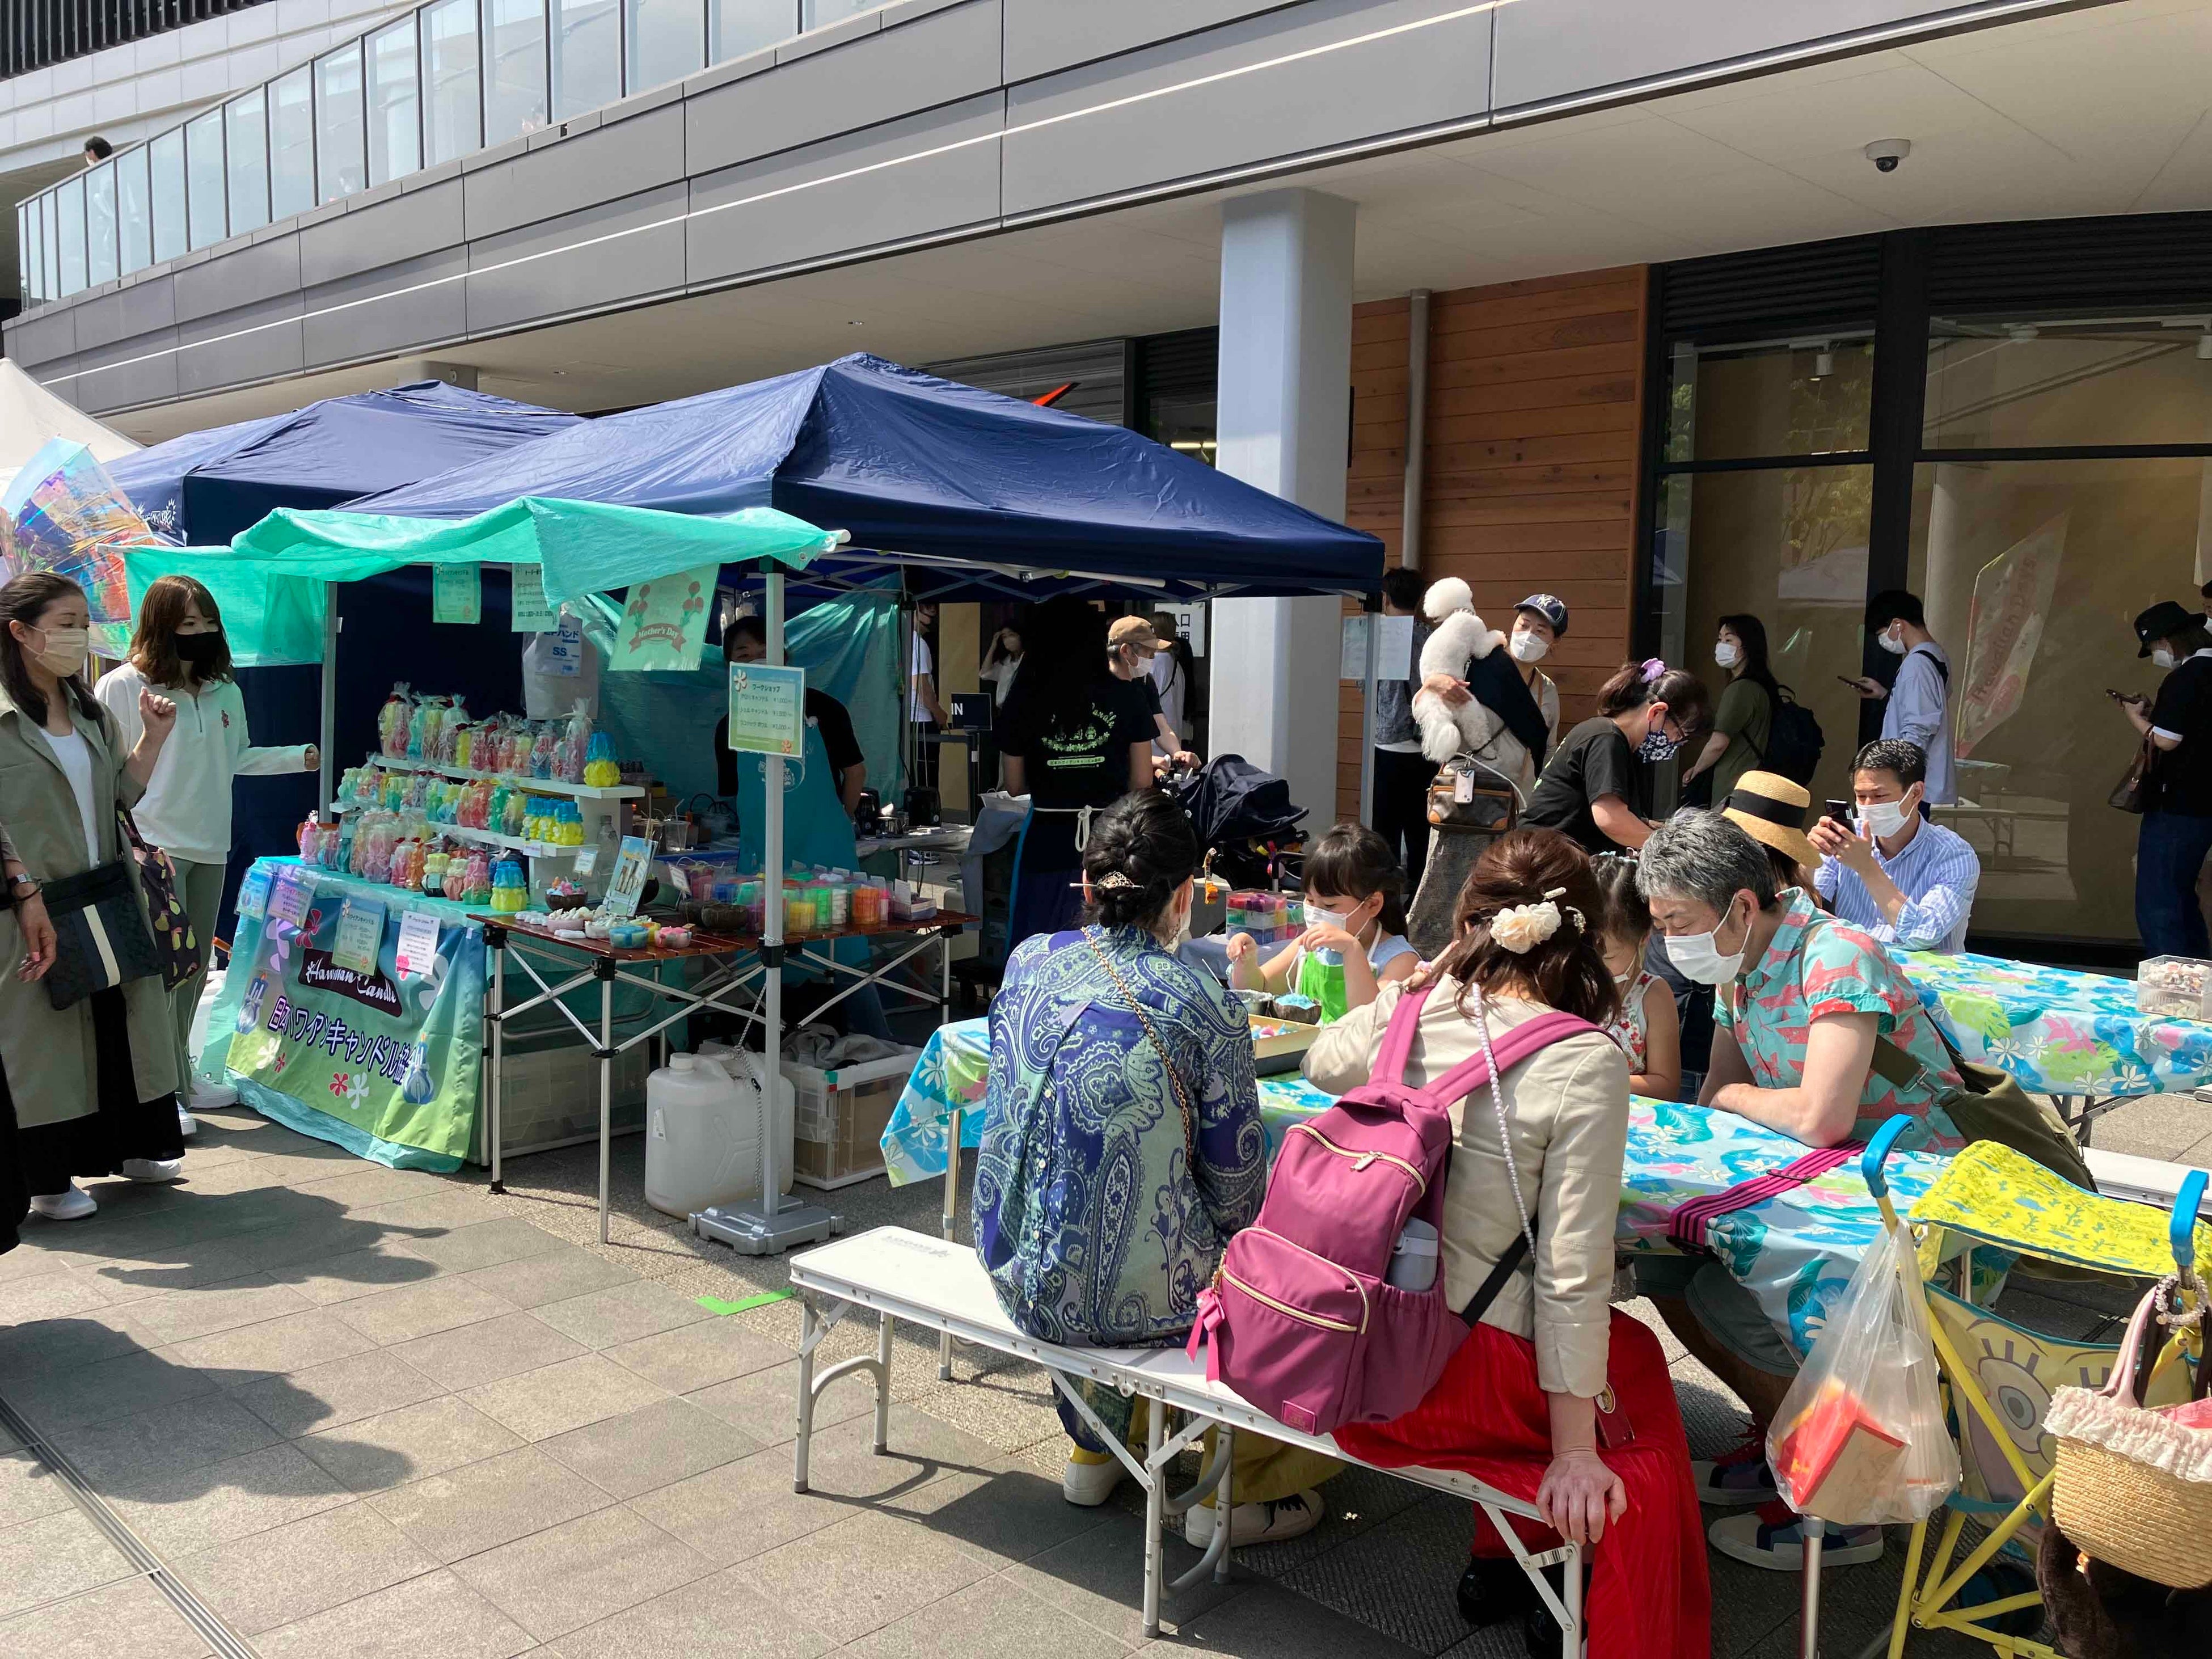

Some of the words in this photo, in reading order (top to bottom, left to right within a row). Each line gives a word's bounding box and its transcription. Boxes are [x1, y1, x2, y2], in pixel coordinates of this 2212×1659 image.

[638, 627, 666, 638] Mother's
[666, 627, 679, 638] Day
[553, 647, 567, 656] SS
[752, 683, 780, 693] ワークショップ
[1092, 703, 1116, 729] andle
